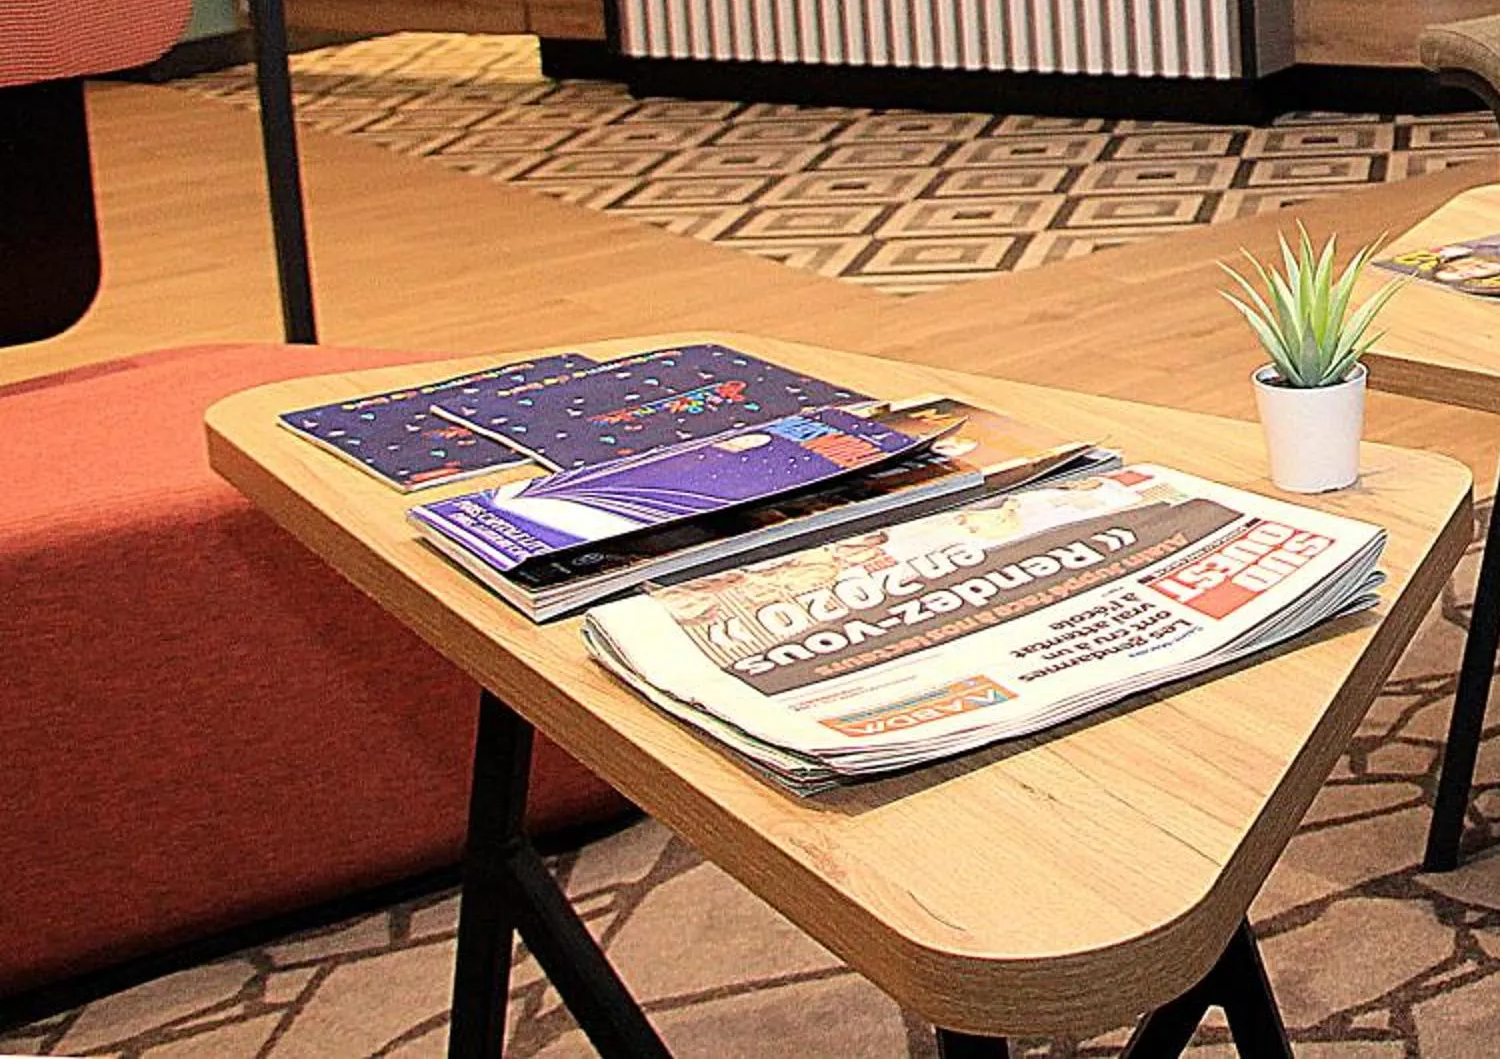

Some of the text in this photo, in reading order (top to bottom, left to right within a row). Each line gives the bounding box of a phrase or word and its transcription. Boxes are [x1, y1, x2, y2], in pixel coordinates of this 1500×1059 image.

[907, 543, 986, 580] en
[1157, 523, 1295, 604] OUEST
[1231, 532, 1334, 592] SUD
[733, 541, 1105, 675] Rendez-vous
[756, 568, 925, 638] 2020
[1010, 601, 1157, 658] vrai attentat
[1048, 592, 1142, 631] à l'école
[1018, 618, 1192, 682] Les gendarmes
[1042, 609, 1172, 660] ont cru à un
